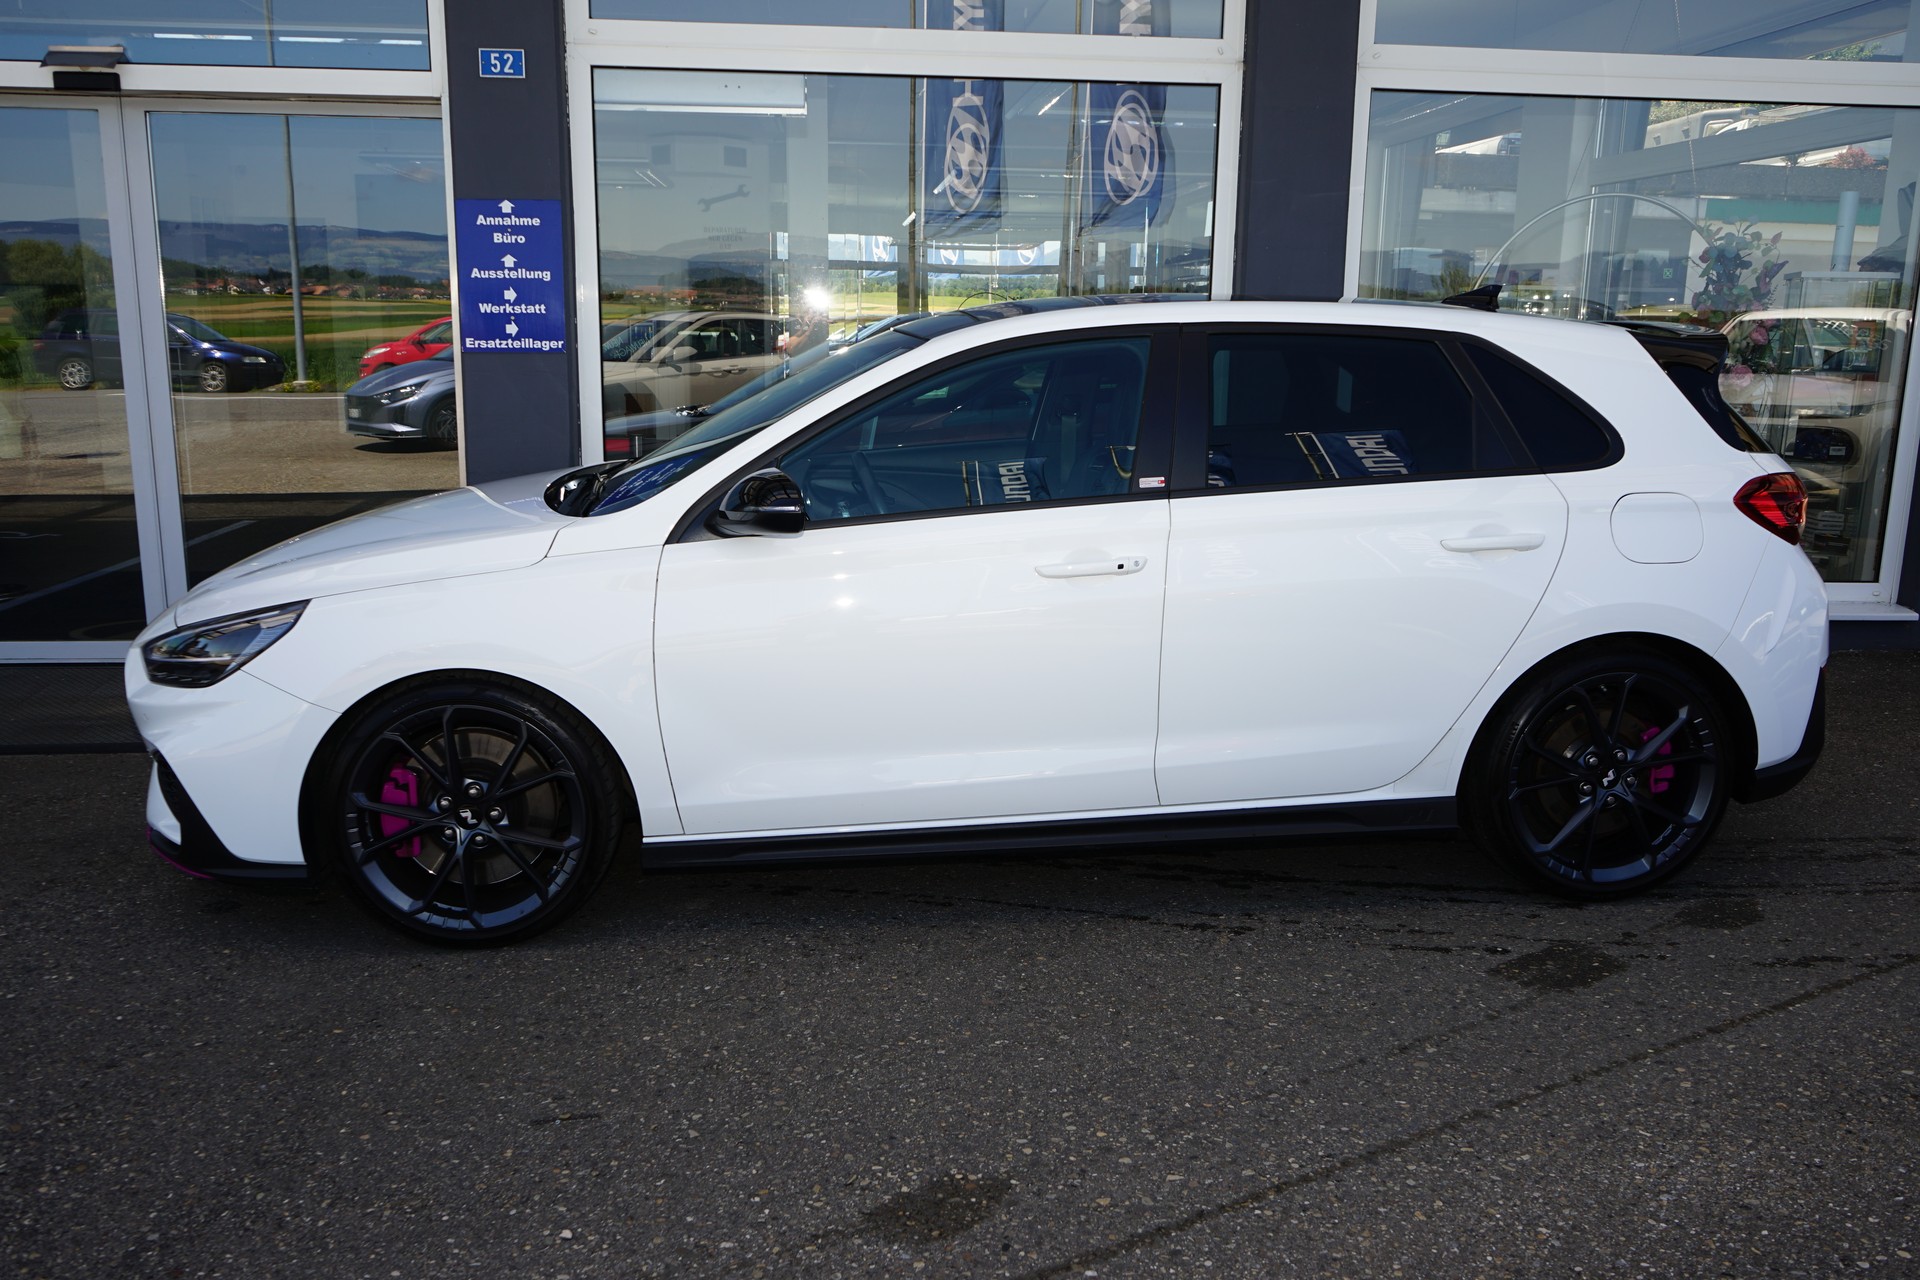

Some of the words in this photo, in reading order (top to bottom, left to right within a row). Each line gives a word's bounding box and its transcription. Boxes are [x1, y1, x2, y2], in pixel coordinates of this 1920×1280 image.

[490, 53, 514, 74] 52
[476, 215, 541, 226] Annahme
[493, 232, 526, 244] Büro
[471, 268, 551, 281] Ausstellung
[479, 302, 546, 315] Werkstatt
[465, 338, 564, 350] Ersatzteillager
